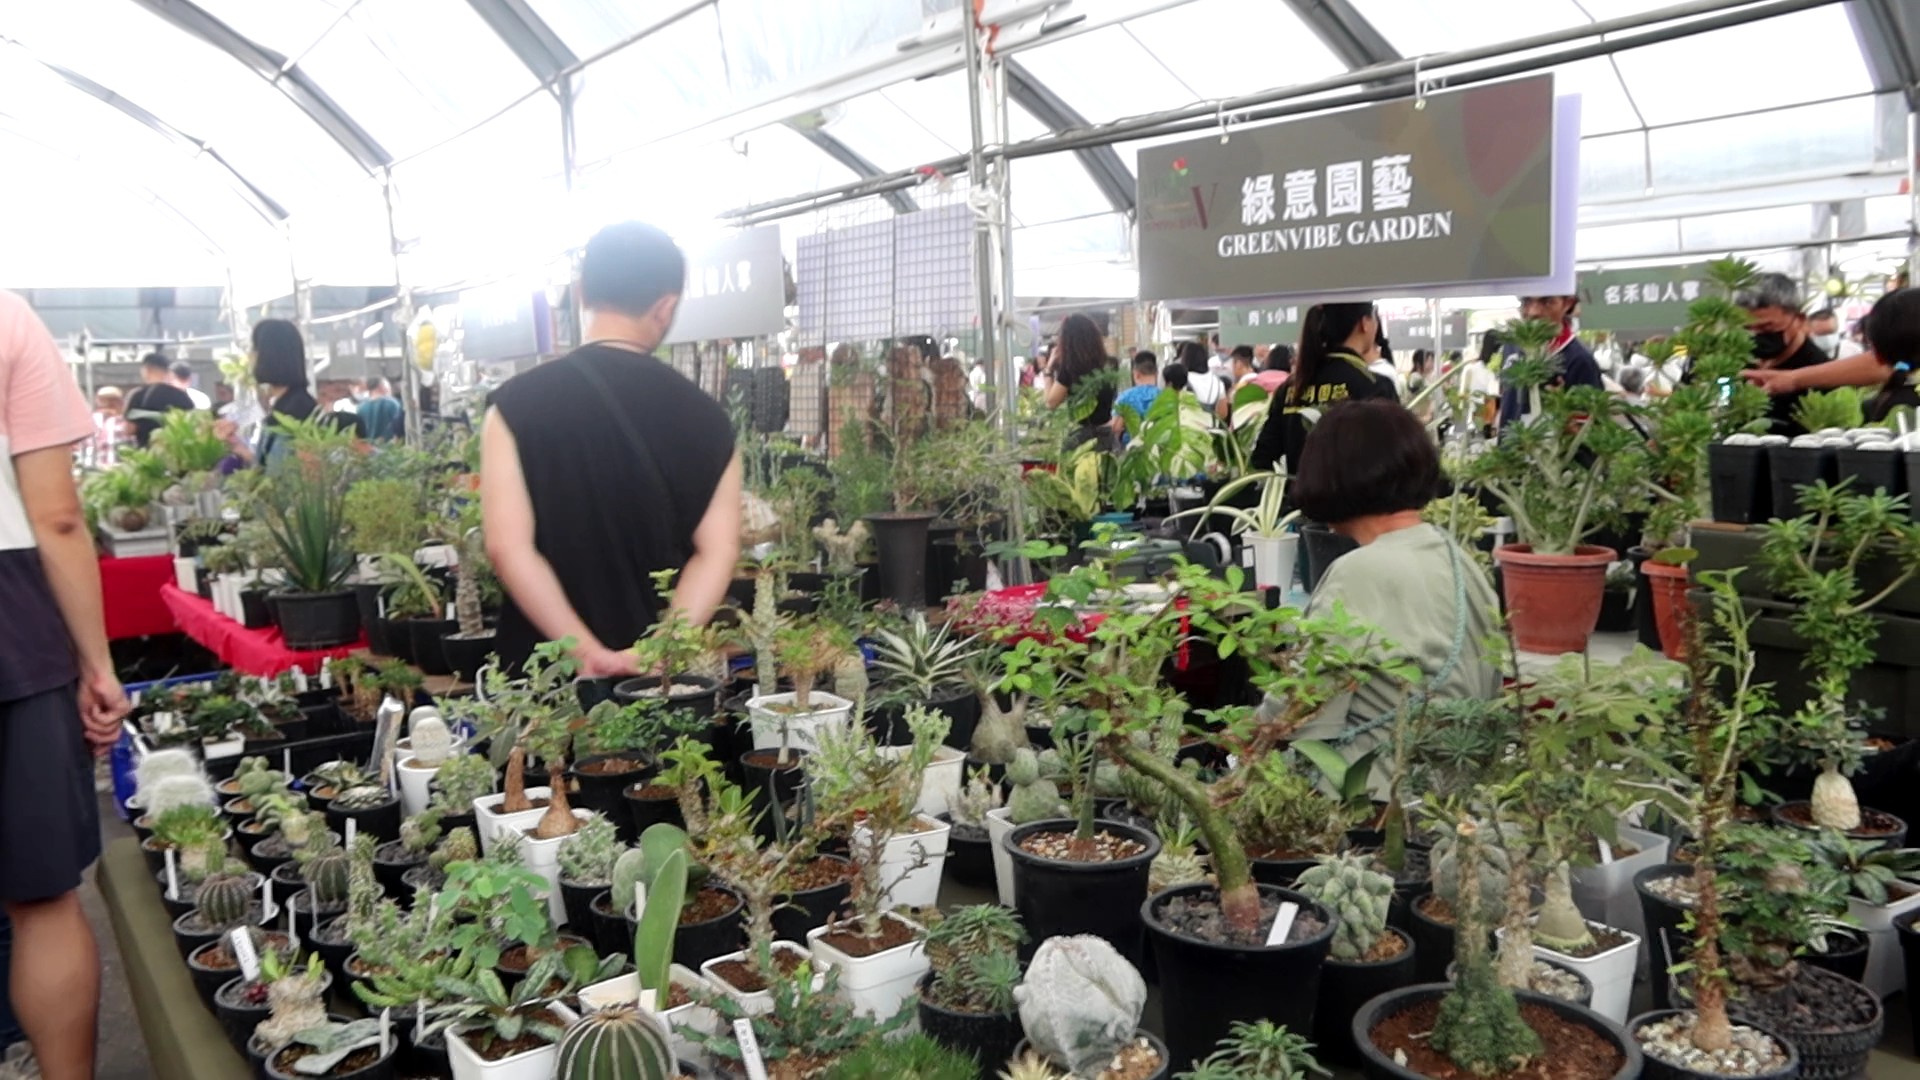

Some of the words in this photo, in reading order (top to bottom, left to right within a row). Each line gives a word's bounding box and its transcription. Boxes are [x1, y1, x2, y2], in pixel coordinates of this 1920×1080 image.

[1241, 154, 1413, 226] 綠意園藝
[1218, 223, 1342, 257] GREENVIBE
[1346, 211, 1453, 245] GARDEN
